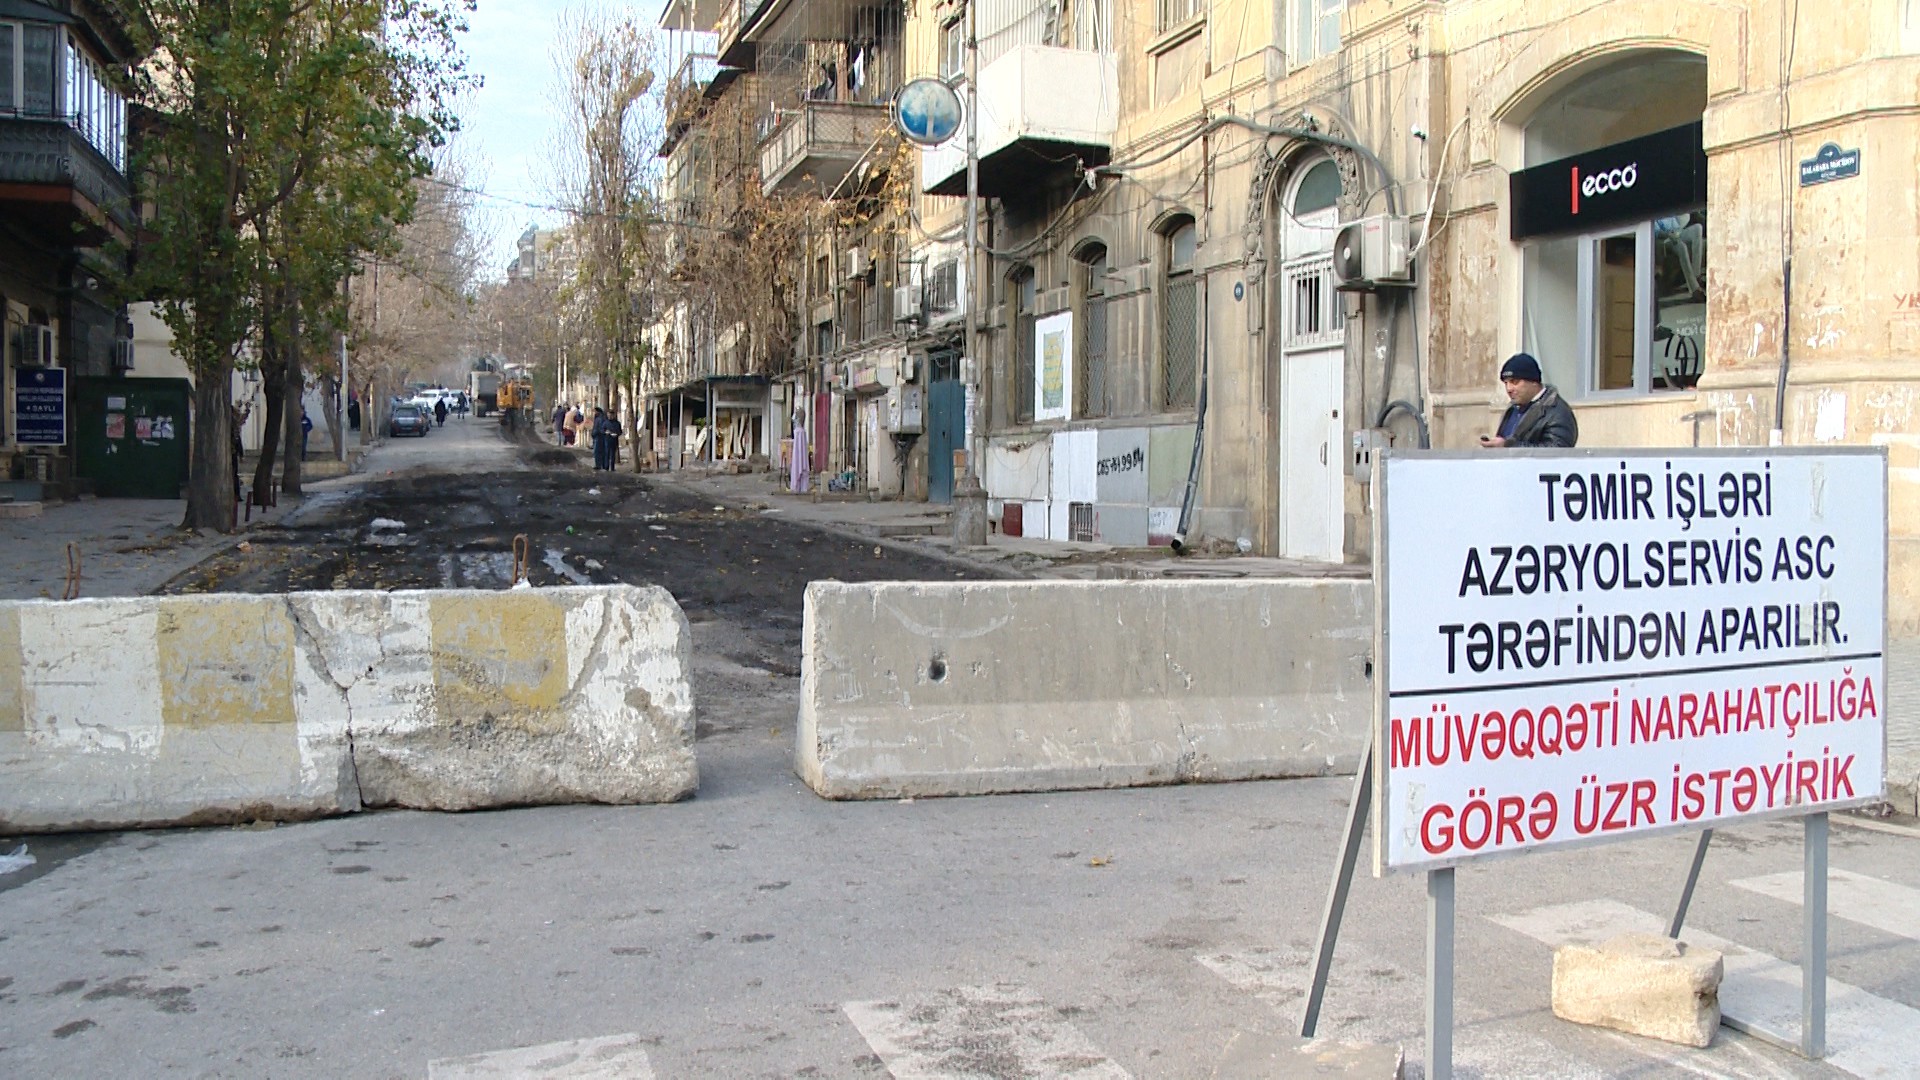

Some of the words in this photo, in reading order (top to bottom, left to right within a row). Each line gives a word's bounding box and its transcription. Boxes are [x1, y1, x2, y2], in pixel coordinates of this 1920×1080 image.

[1582, 165, 1637, 197] ecco
[1539, 460, 1656, 522] TƏMİR
[1665, 460, 1772, 531] İŞLƏRİ
[1458, 527, 1763, 598] AZƏRYOLSERVİS
[1771, 535, 1836, 582] ASC
[1438, 603, 1686, 674] TƏRƏFİNDƏN
[1695, 601, 1848, 655] APARILIR.
[1391, 687, 1619, 768] MÜVƏQQƏTİ
[1630, 665, 1877, 745] NARAHATÇILIĞA
[1420, 788, 1558, 854] GÖRƏ
[1573, 774, 1657, 835] ÜZR
[1671, 745, 1855, 822] İSTƏYİRİK
